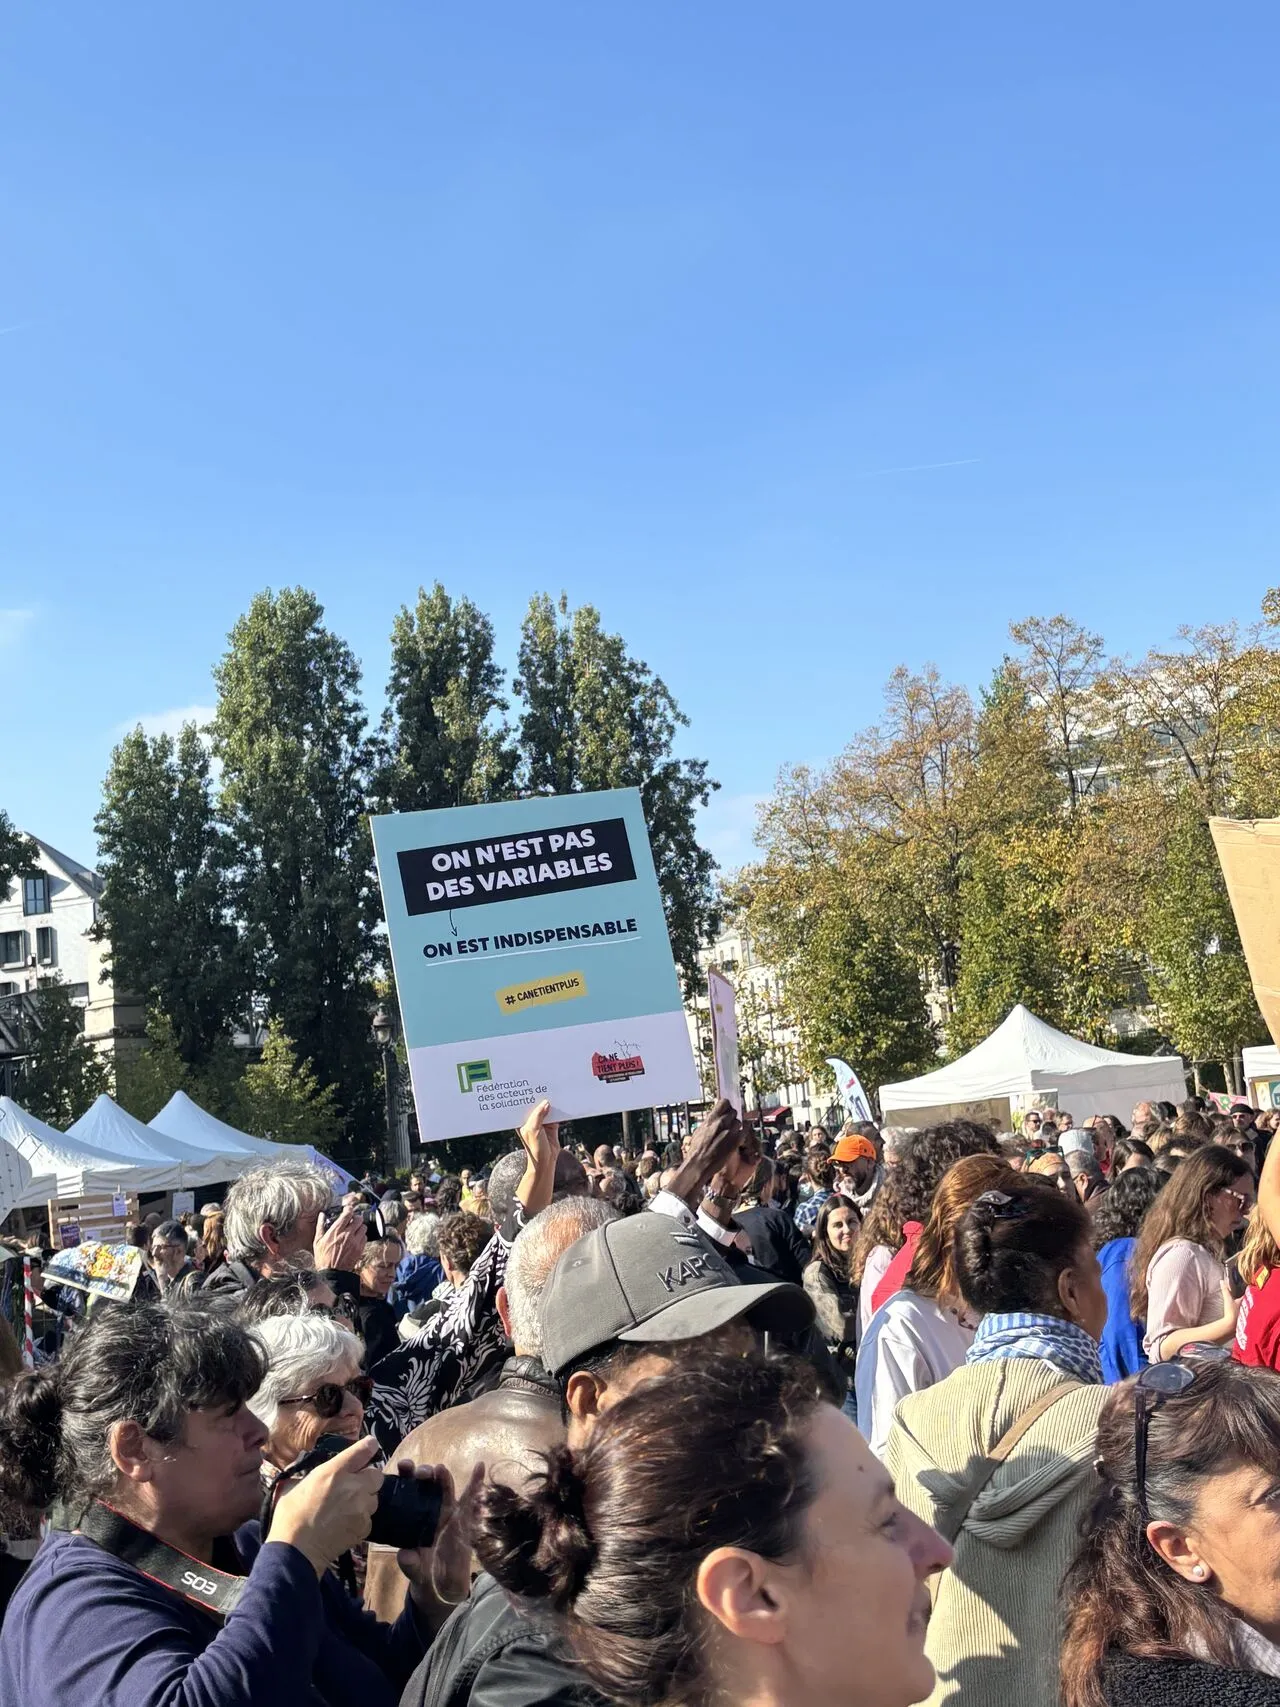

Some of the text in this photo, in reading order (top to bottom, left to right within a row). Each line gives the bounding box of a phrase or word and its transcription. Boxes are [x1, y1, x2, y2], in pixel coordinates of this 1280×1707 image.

[431, 828, 596, 872] ON N'EST PAS
[426, 853, 613, 901] DES VARIABLES
[423, 918, 638, 958] ON EST INDISPENSABLE
[517, 978, 580, 1001] CANETIENTPLUS
[597, 1062, 617, 1073] TIENT
[476, 1079, 530, 1093] Fédération
[477, 1084, 548, 1103] des acteurs de
[479, 1095, 536, 1111] la solidarité
[180, 1571, 218, 1595] EOS
